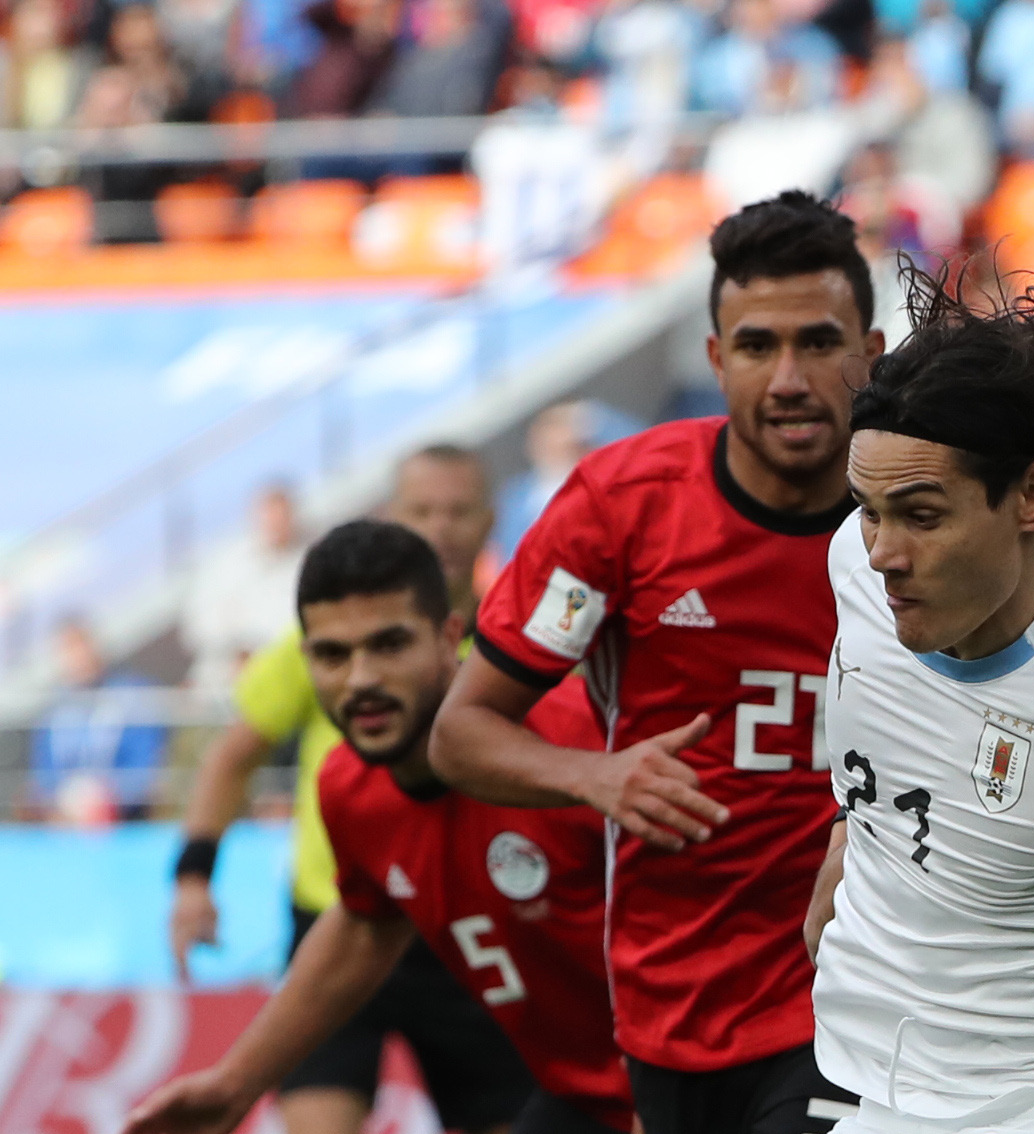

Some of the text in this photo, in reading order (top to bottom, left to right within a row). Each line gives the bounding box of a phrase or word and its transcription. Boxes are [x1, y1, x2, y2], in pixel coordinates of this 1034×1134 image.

[733, 669, 830, 772] 21
[844, 749, 931, 873] 21
[450, 914, 526, 1006] 5
